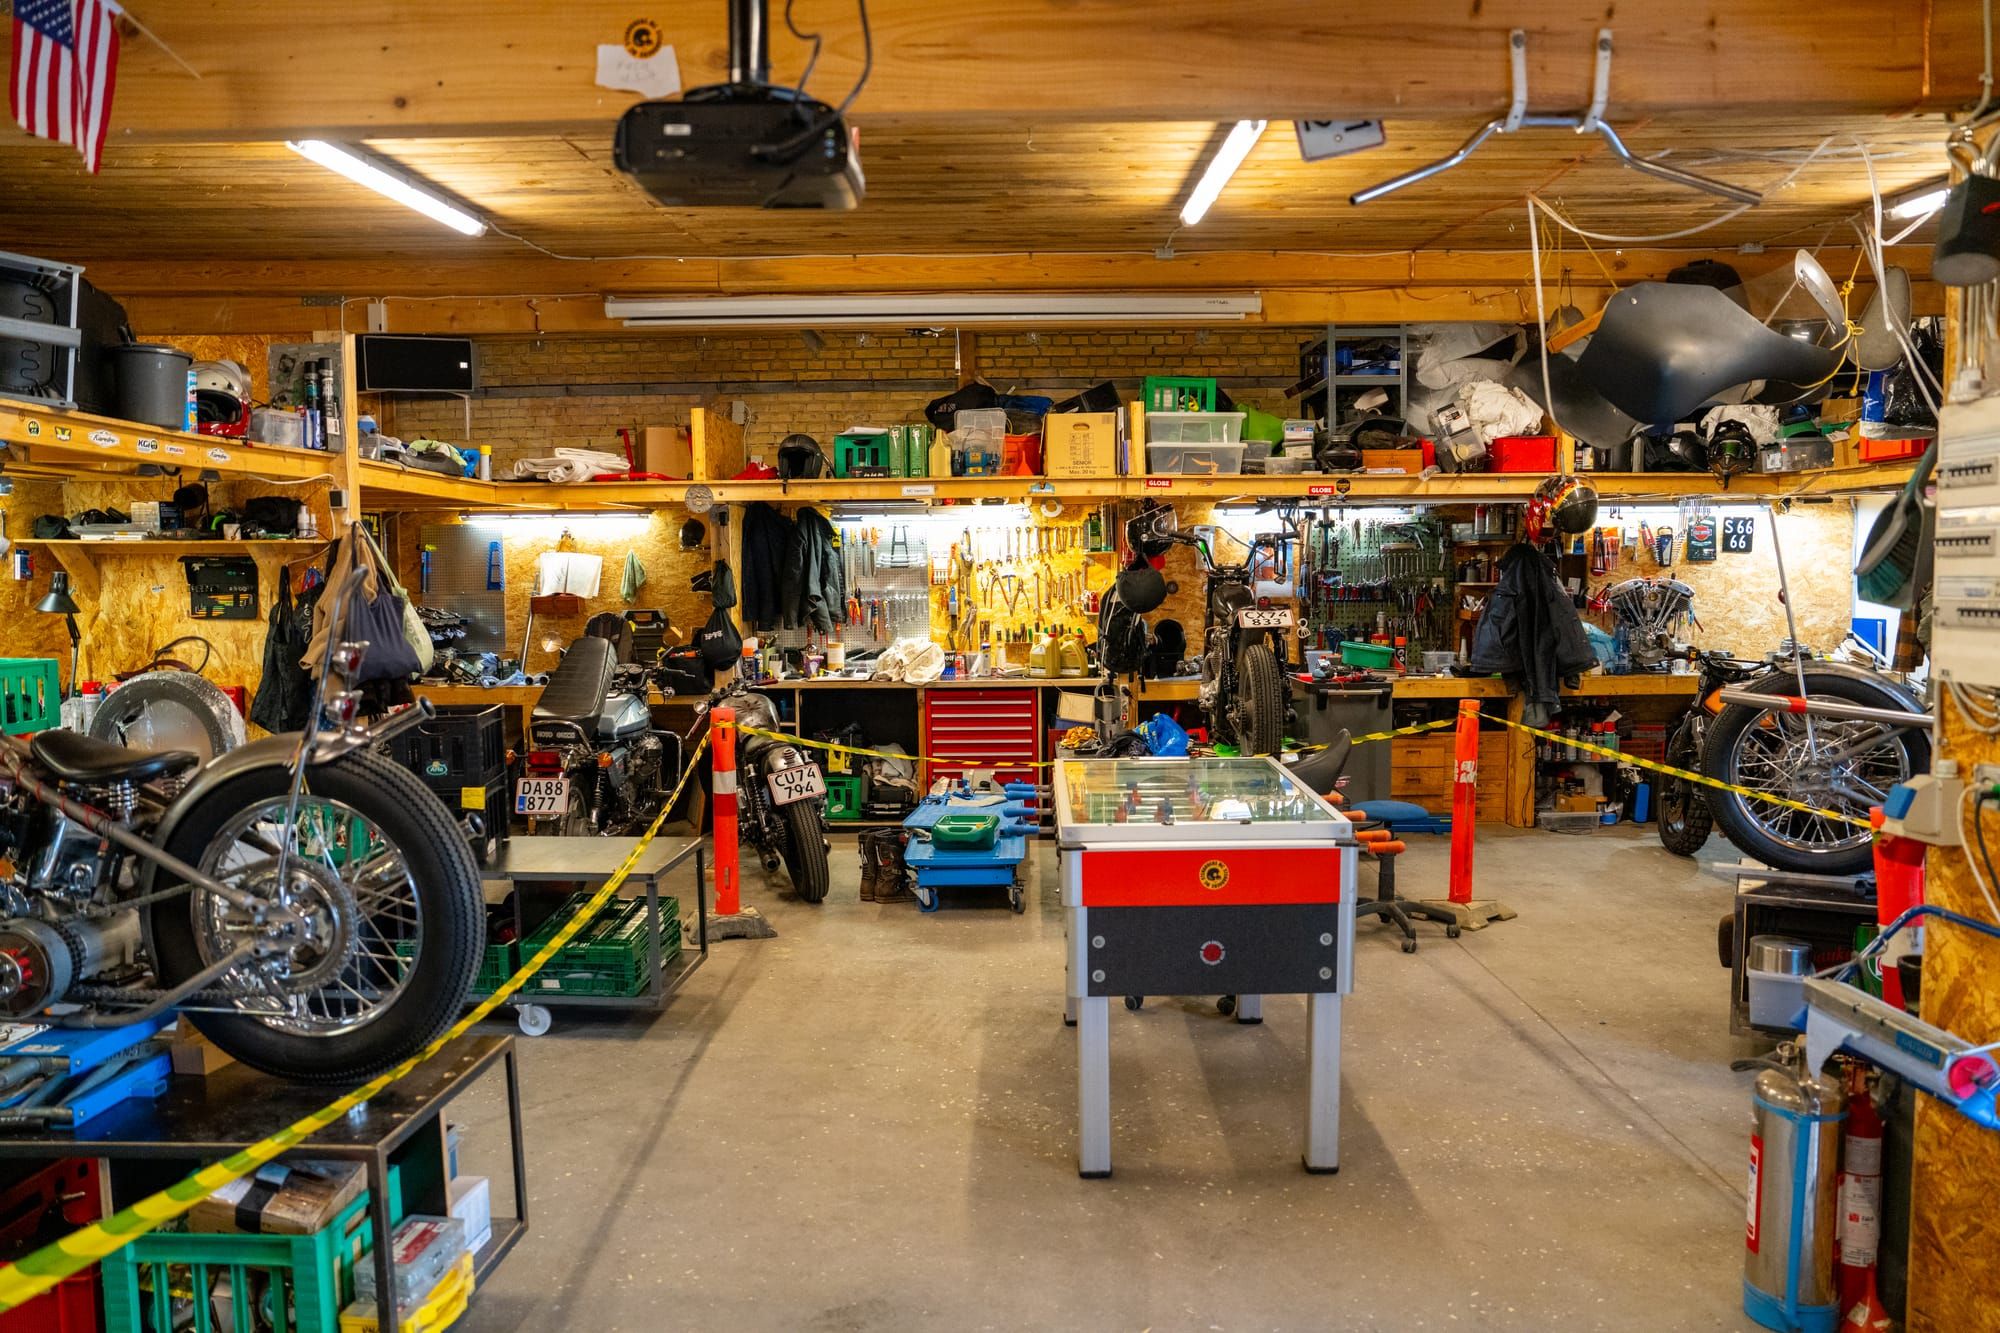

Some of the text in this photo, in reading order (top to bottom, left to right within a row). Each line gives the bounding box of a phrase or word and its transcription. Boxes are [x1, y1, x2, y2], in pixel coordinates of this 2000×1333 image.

[1724, 520, 1734, 534] S
[1737, 520, 1753, 534] 66
[1730, 535, 1746, 549] 66
[1245, 611, 1288, 619] CX74
[1252, 618, 1282, 626] 833
[774, 767, 816, 787] CU74
[522, 781, 563, 796] DA88
[784, 782, 814, 799] 794
[527, 796, 556, 811] 877
